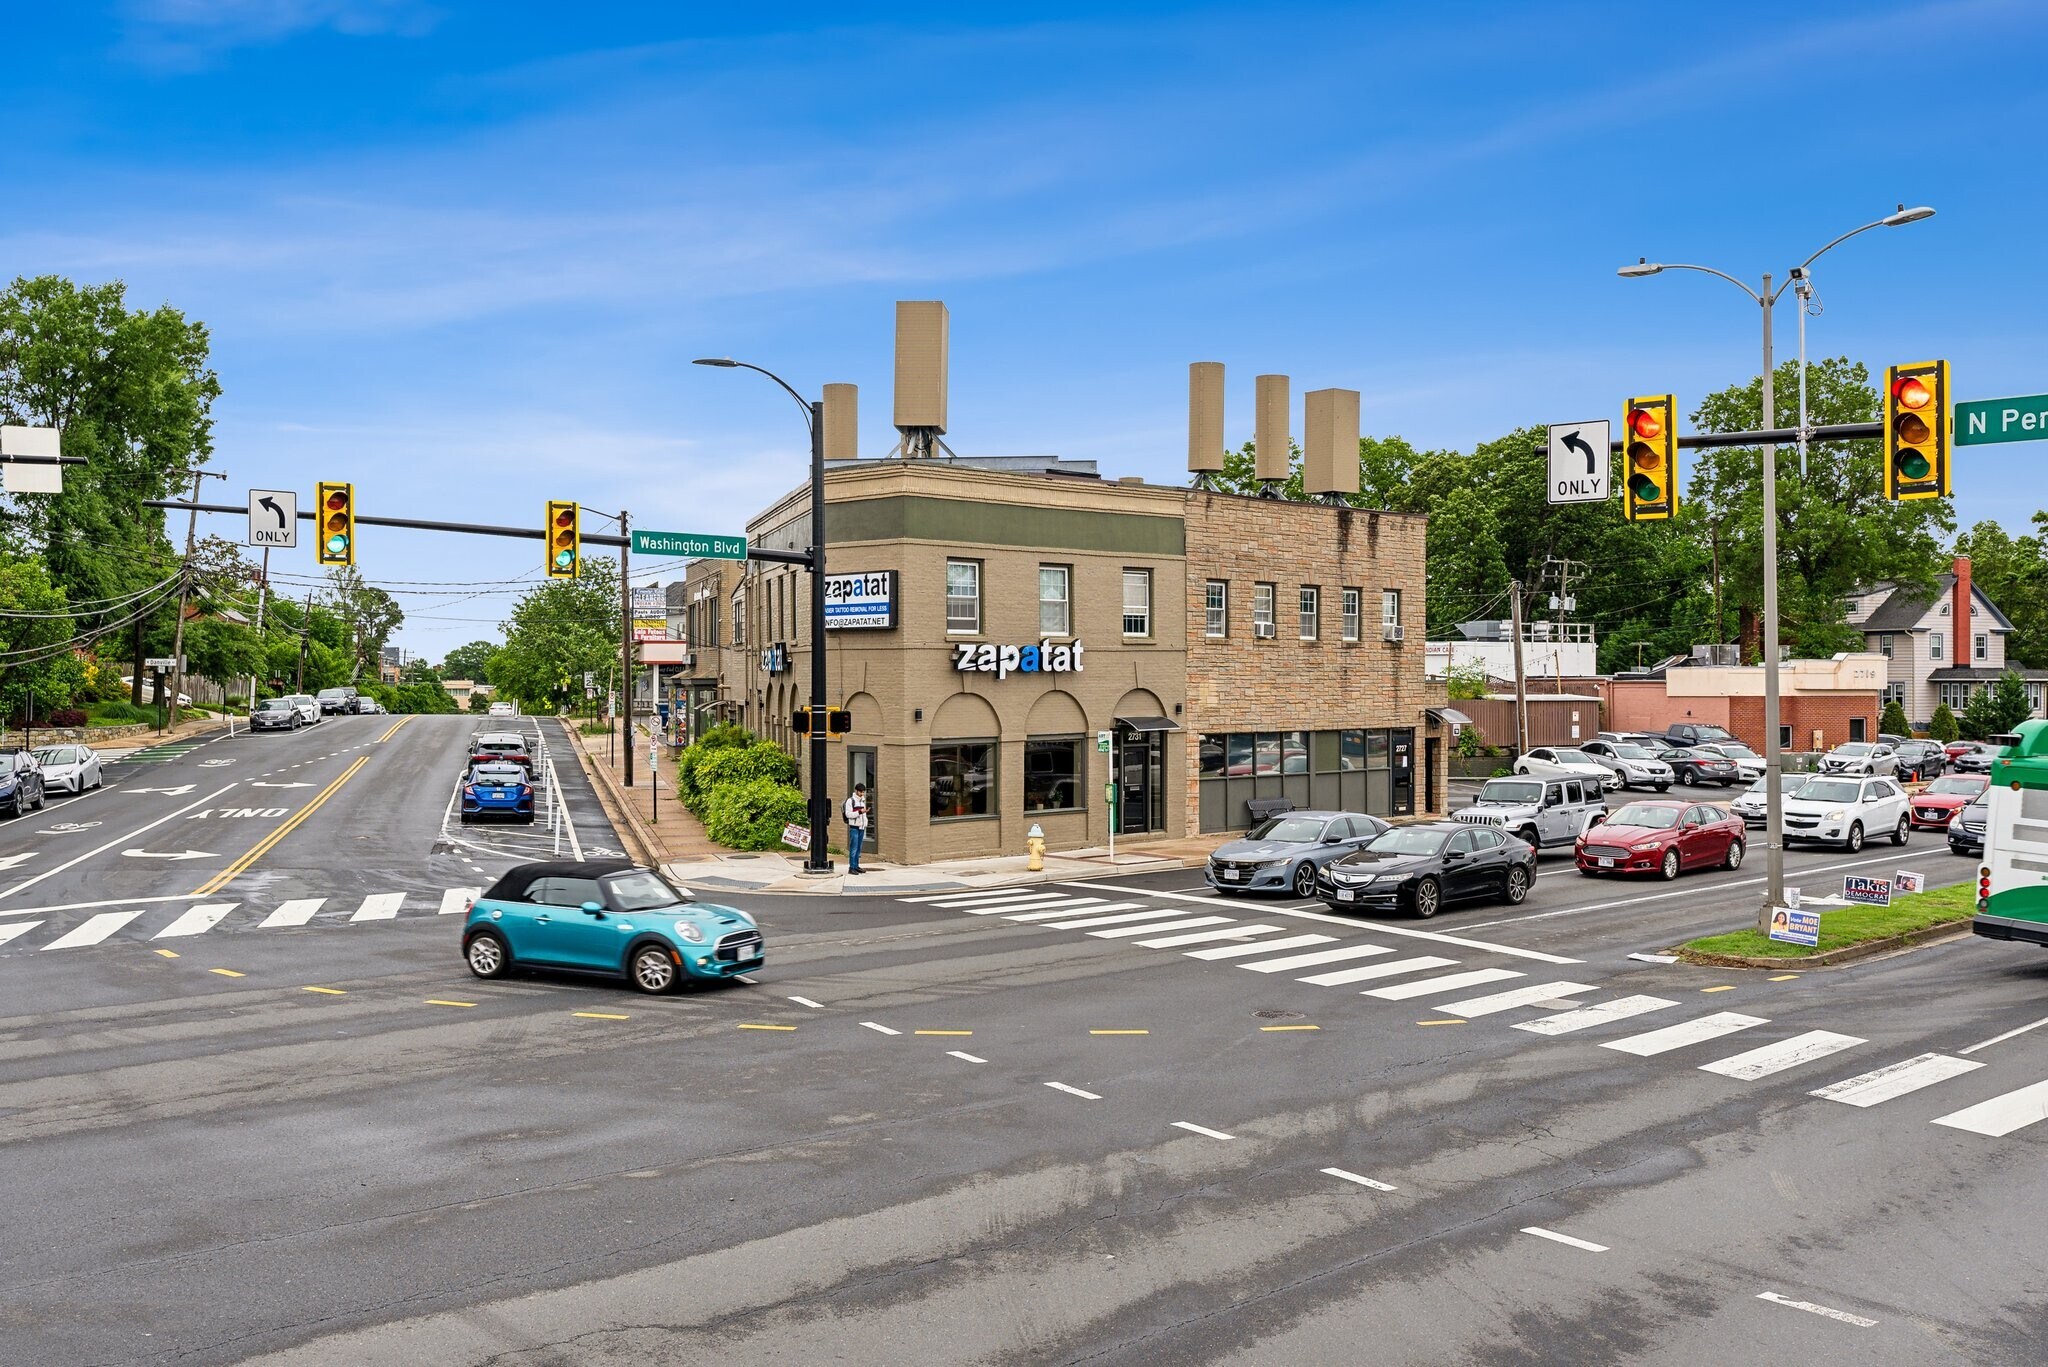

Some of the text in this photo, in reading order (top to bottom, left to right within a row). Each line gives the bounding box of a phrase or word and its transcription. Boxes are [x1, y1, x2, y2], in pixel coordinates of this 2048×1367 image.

[1969, 411, 1986, 435] N
[1558, 478, 1601, 496] ONLY
[256, 530, 290, 543] ONLY
[640, 536, 740, 555] Washington Blvd
[825, 573, 887, 603] zapatat
[825, 617, 885, 626] NFO@ZAPATAT.NET
[957, 638, 1084, 680] zapatat
[1128, 732, 1142, 741] 2731
[1395, 744, 1408, 753] 2727
[185, 808, 290, 819] ONLY
[1848, 877, 1888, 893] Takis
[1845, 890, 1889, 900] DEMOCRAT
[1802, 916, 1818, 926] MOE
[1789, 923, 1818, 934] BRYANT
